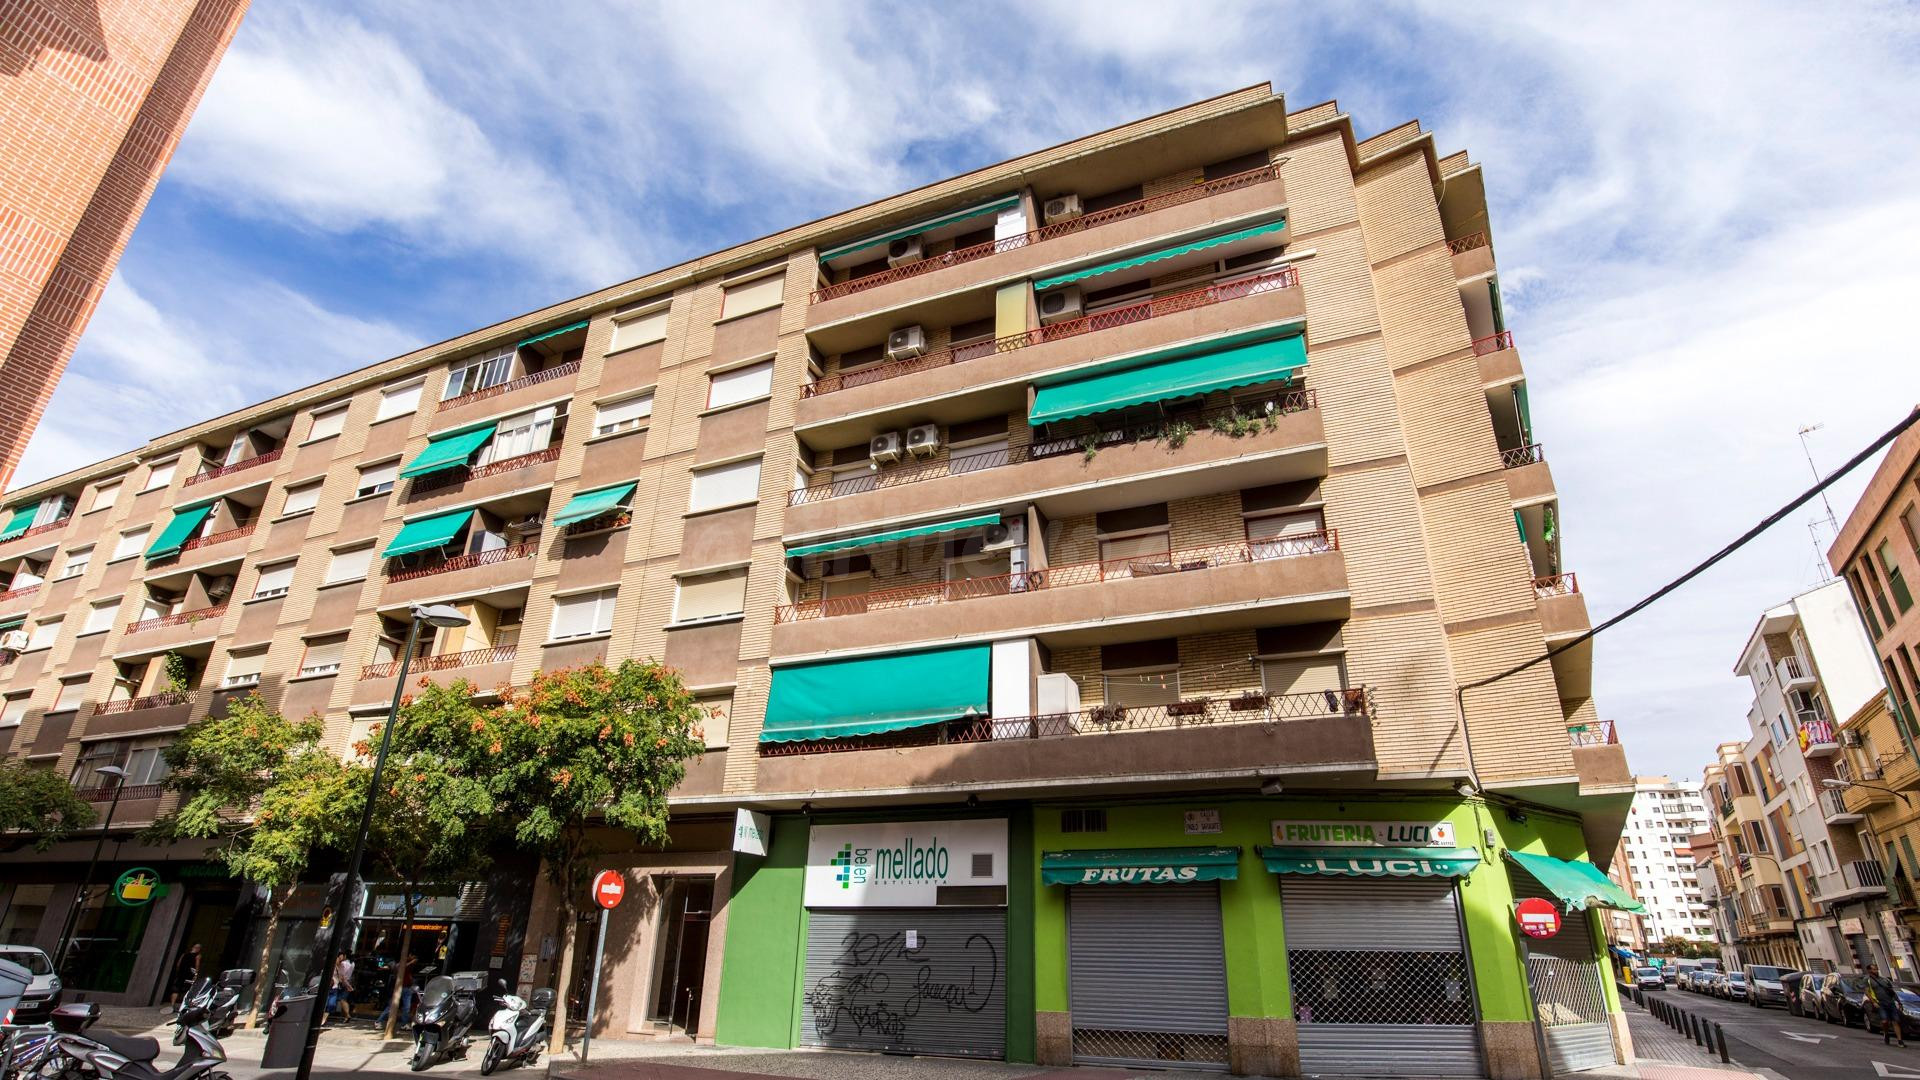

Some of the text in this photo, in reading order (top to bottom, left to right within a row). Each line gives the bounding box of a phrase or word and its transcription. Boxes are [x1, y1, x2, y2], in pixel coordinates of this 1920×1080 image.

[1286, 825, 1428, 842] FRUTERIA LUCI
[853, 848, 872, 884] belen
[875, 836, 948, 879] mellado
[1082, 867, 1198, 881] FRUTAS
